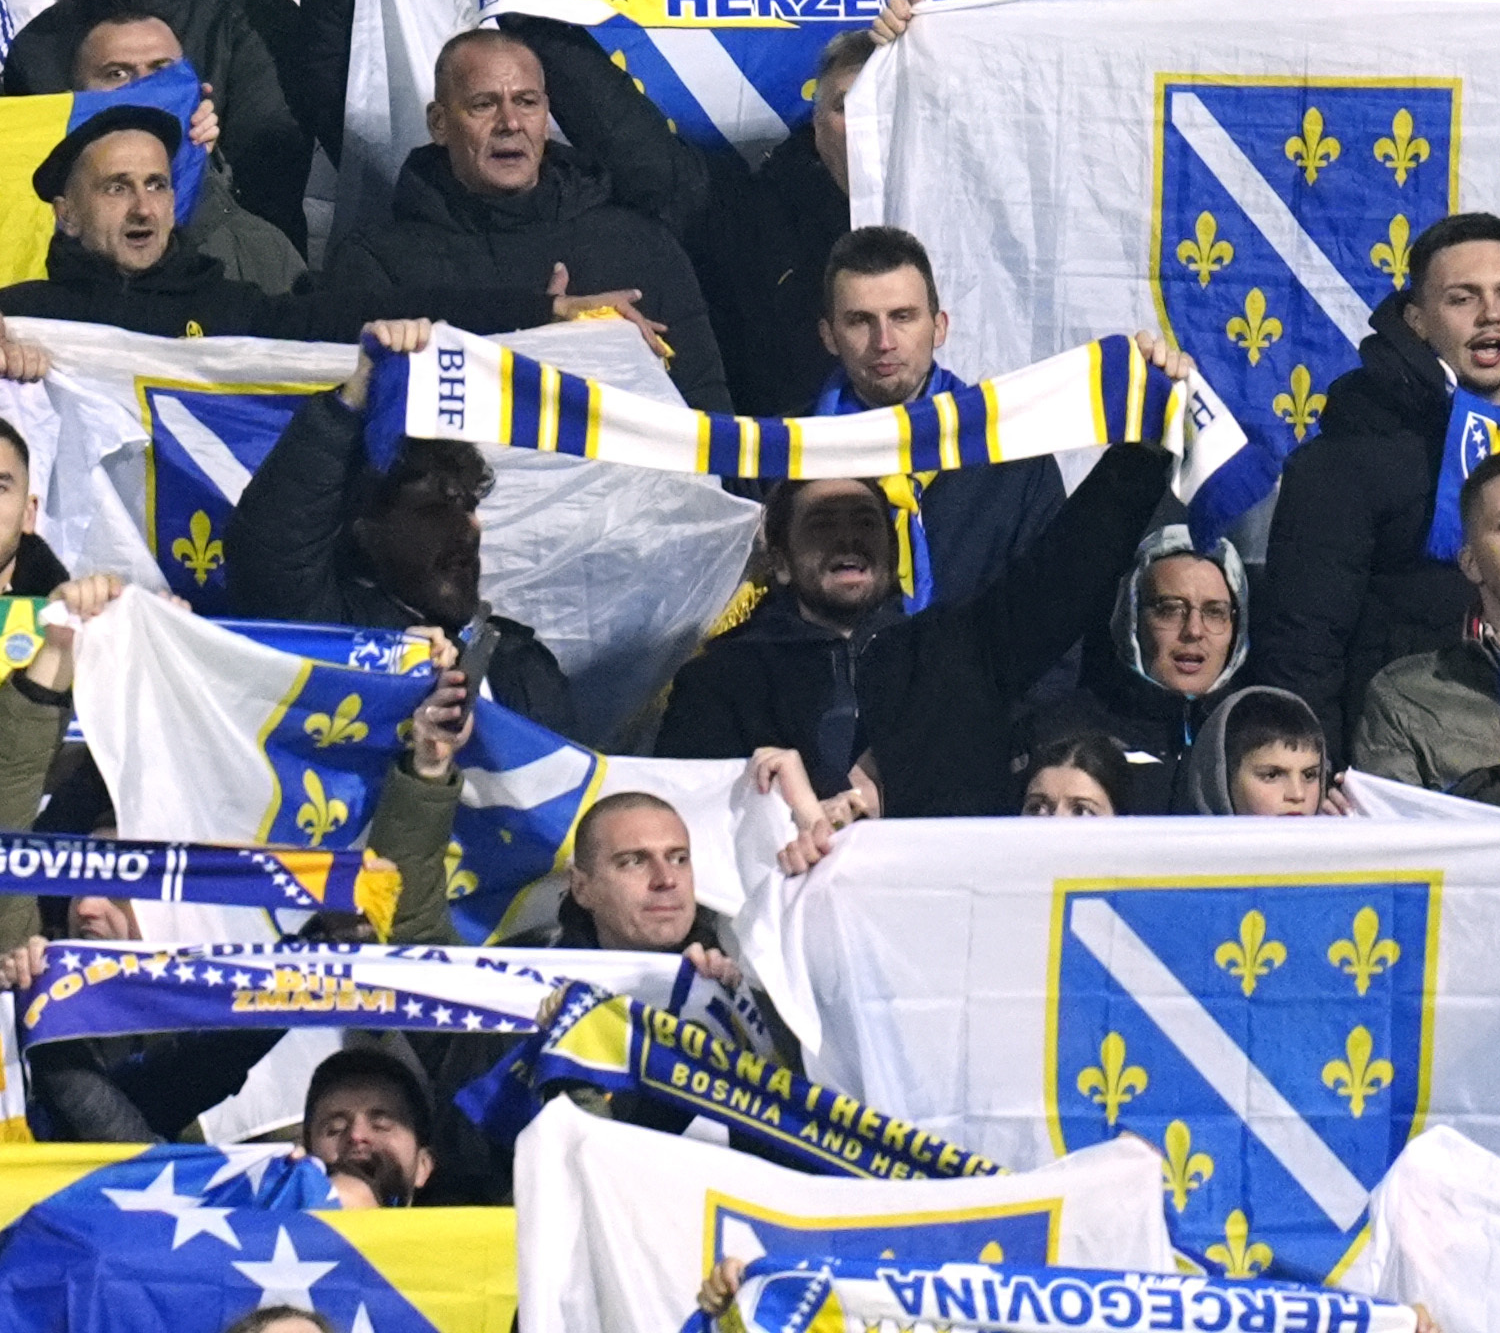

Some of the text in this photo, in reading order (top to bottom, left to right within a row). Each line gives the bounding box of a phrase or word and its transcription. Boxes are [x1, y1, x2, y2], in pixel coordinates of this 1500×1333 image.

[437, 346, 466, 431] BHF
[653, 1010, 793, 1098] BOSNA
[670, 1060, 862, 1161] BOSNIA AND
[880, 1270, 1371, 1333] HERCEGOVINA
